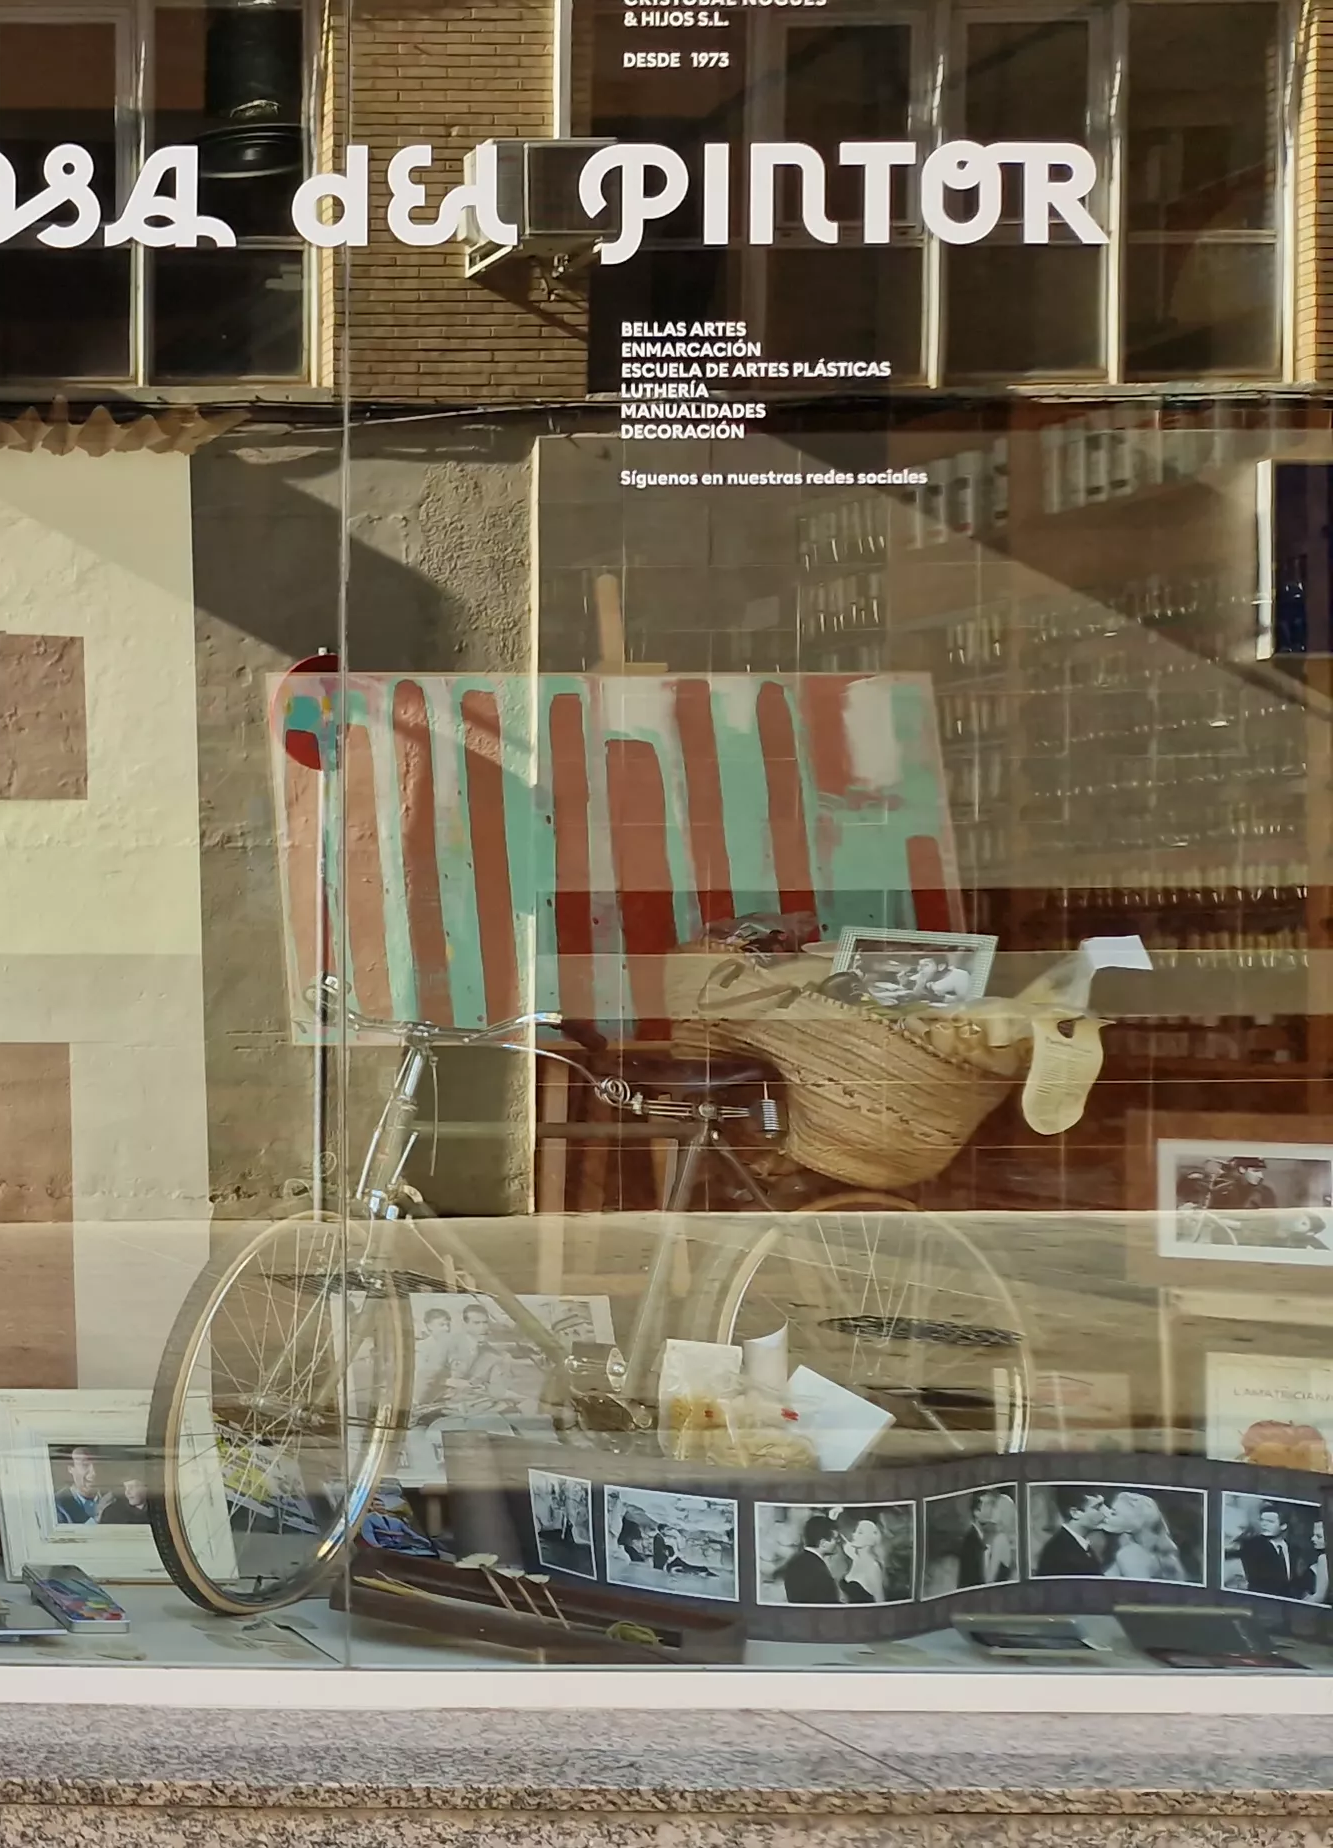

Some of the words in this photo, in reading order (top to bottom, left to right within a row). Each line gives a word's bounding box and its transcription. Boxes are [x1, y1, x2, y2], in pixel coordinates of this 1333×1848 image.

[624, 11, 638, 27] &
[641, 11, 694, 27] HIJOS
[697, 11, 729, 27] S.L.
[623, 52, 681, 68] DESDE
[690, 52, 730, 68] 1973
[621, 322, 687, 337] BELLAS
[689, 322, 747, 337] ARTES
[621, 339, 761, 357] ENMARCACIÓN
[621, 362, 703, 378] ESCUELA
[705, 362, 729, 378] DE
[732, 362, 789, 377] ARTES
[793, 358, 891, 377] PLÁSTICAS
[621, 380, 709, 399] LUTHERÍA
[621, 403, 766, 419] MANUALIDADES
[621, 420, 745, 439] DECORACIÓN
[620, 470, 698, 489] Síguenos
[701, 473, 723, 485] en
[727, 471, 803, 485] nuestras
[806, 469, 855, 485] redes
[857, 469, 928, 484] sociales
